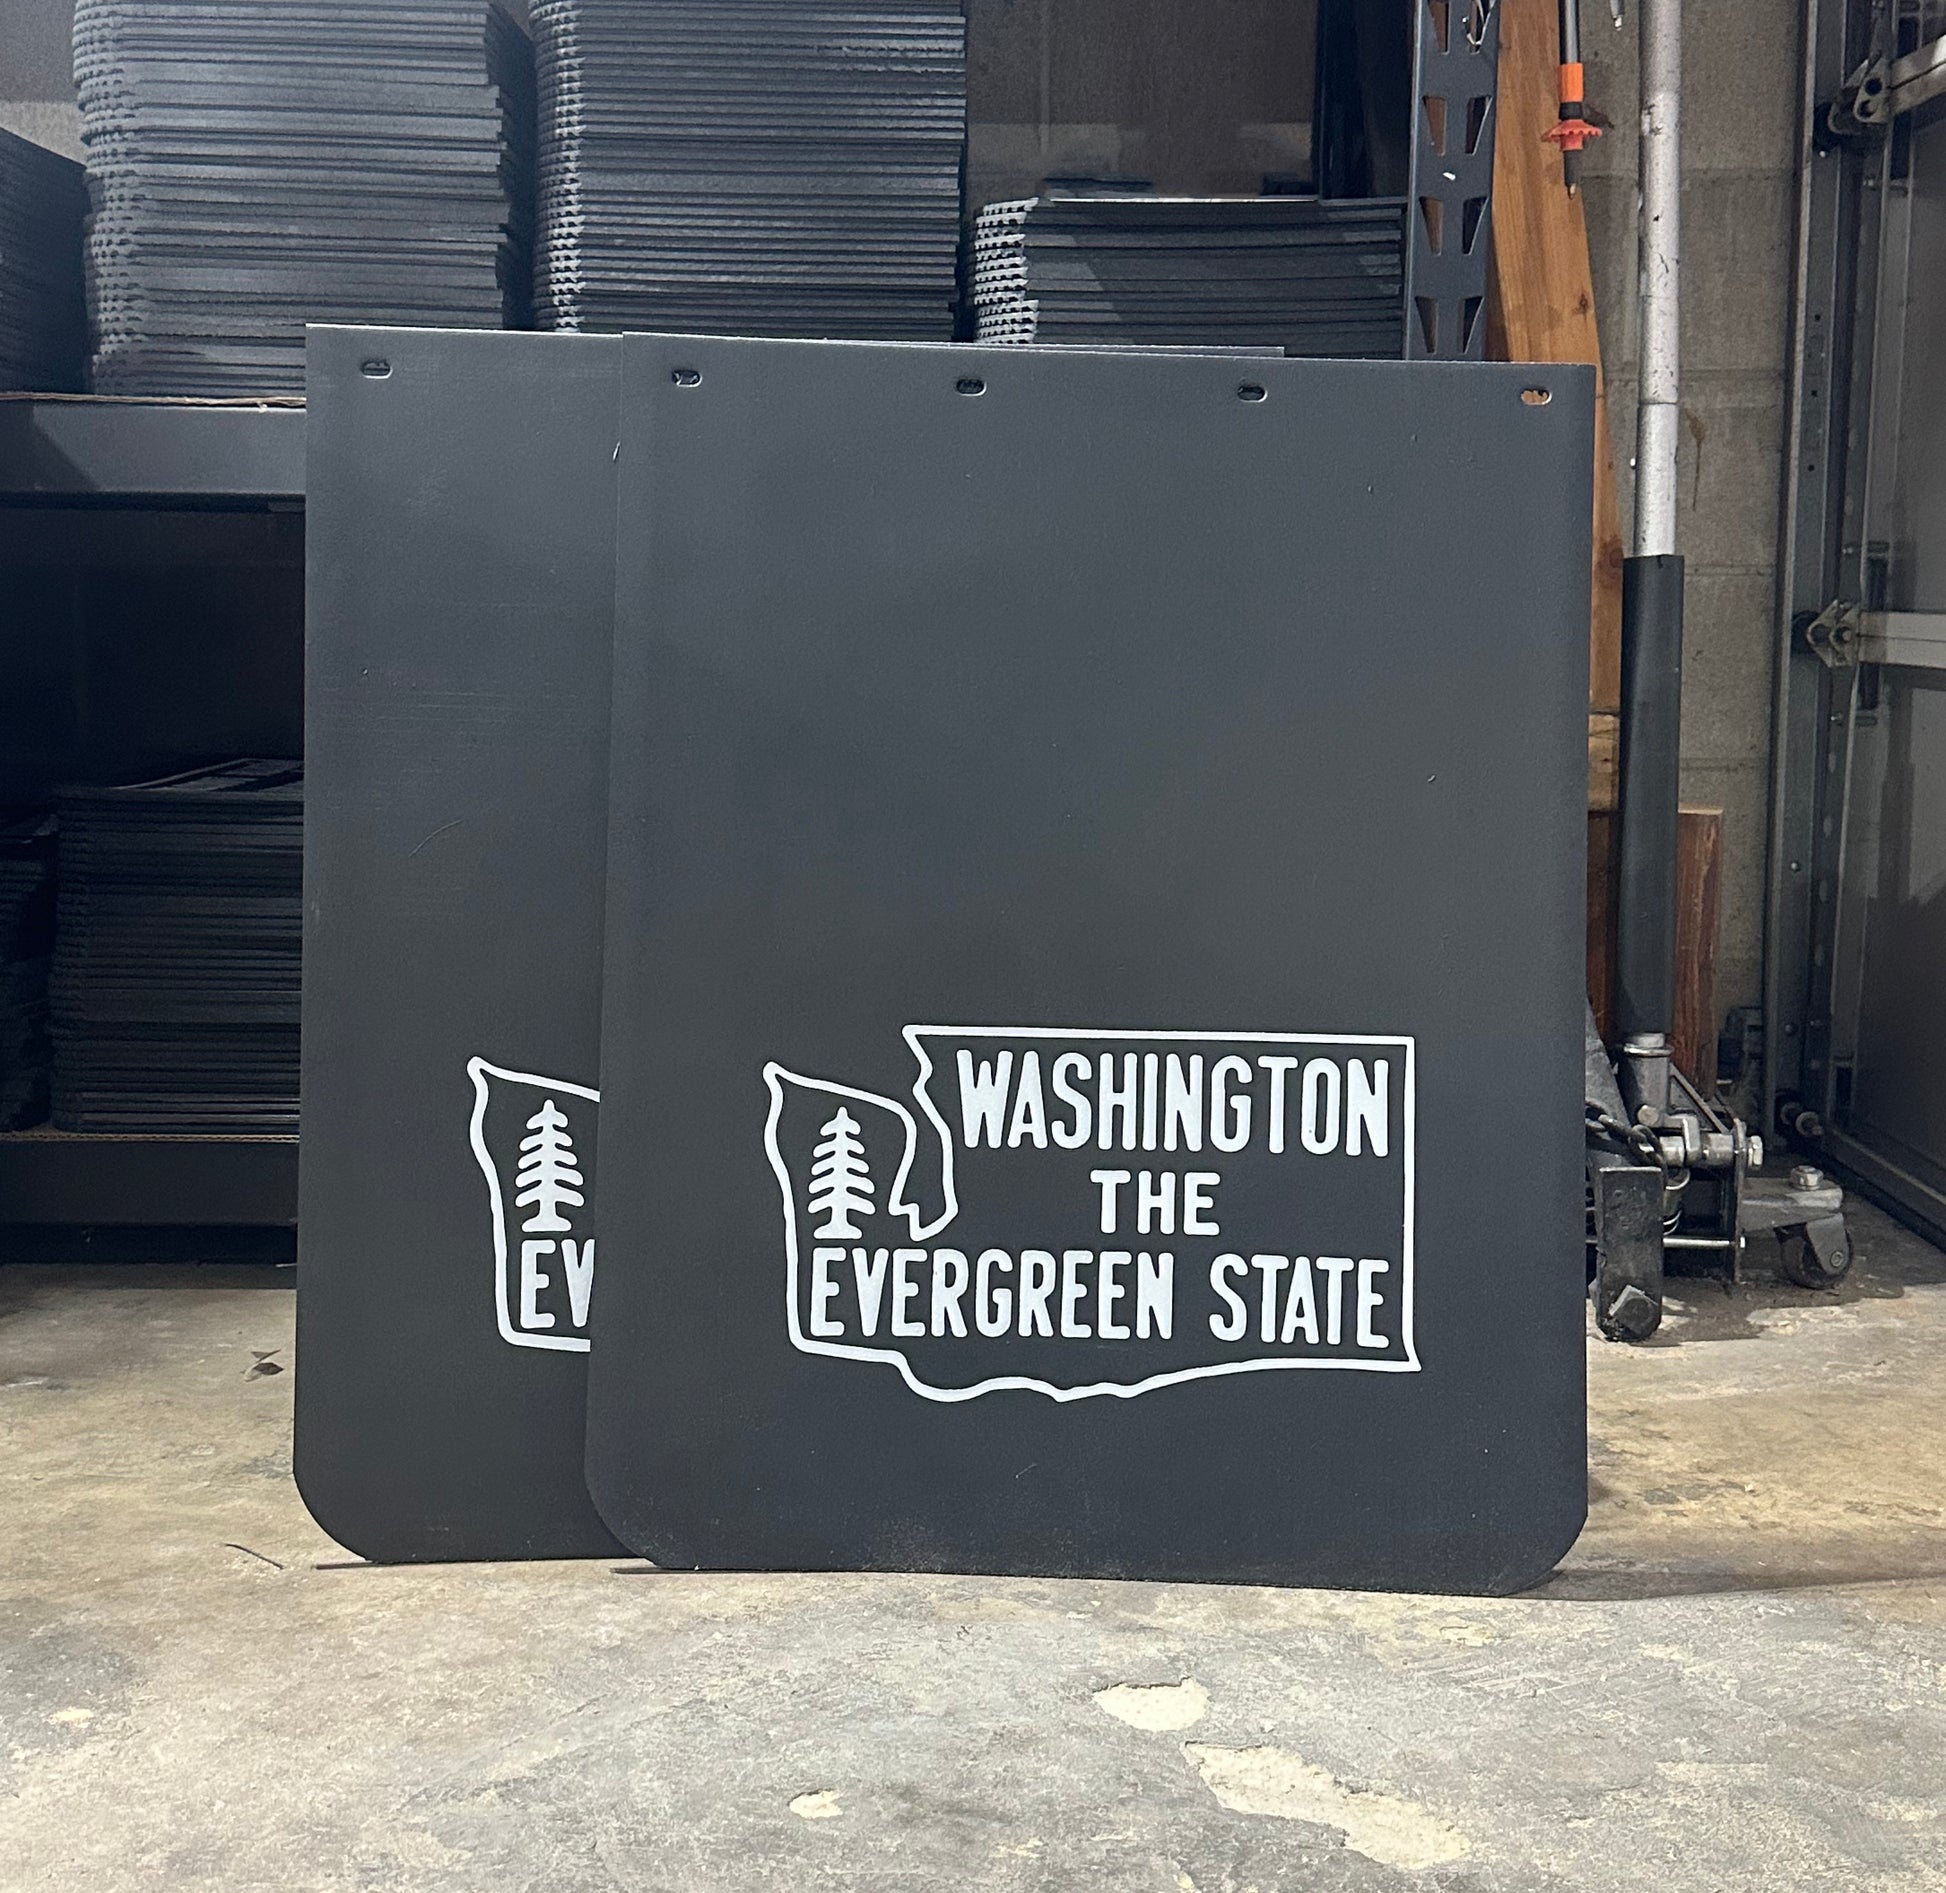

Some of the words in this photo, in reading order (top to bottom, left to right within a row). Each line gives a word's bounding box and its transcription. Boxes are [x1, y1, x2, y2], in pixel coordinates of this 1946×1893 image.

[956, 1049, 1390, 1157] WASHINGTON
[1090, 1169, 1222, 1237] THE
[810, 1247, 1174, 1340] EVERGREEN
[1209, 1253, 1391, 1349] STATE
